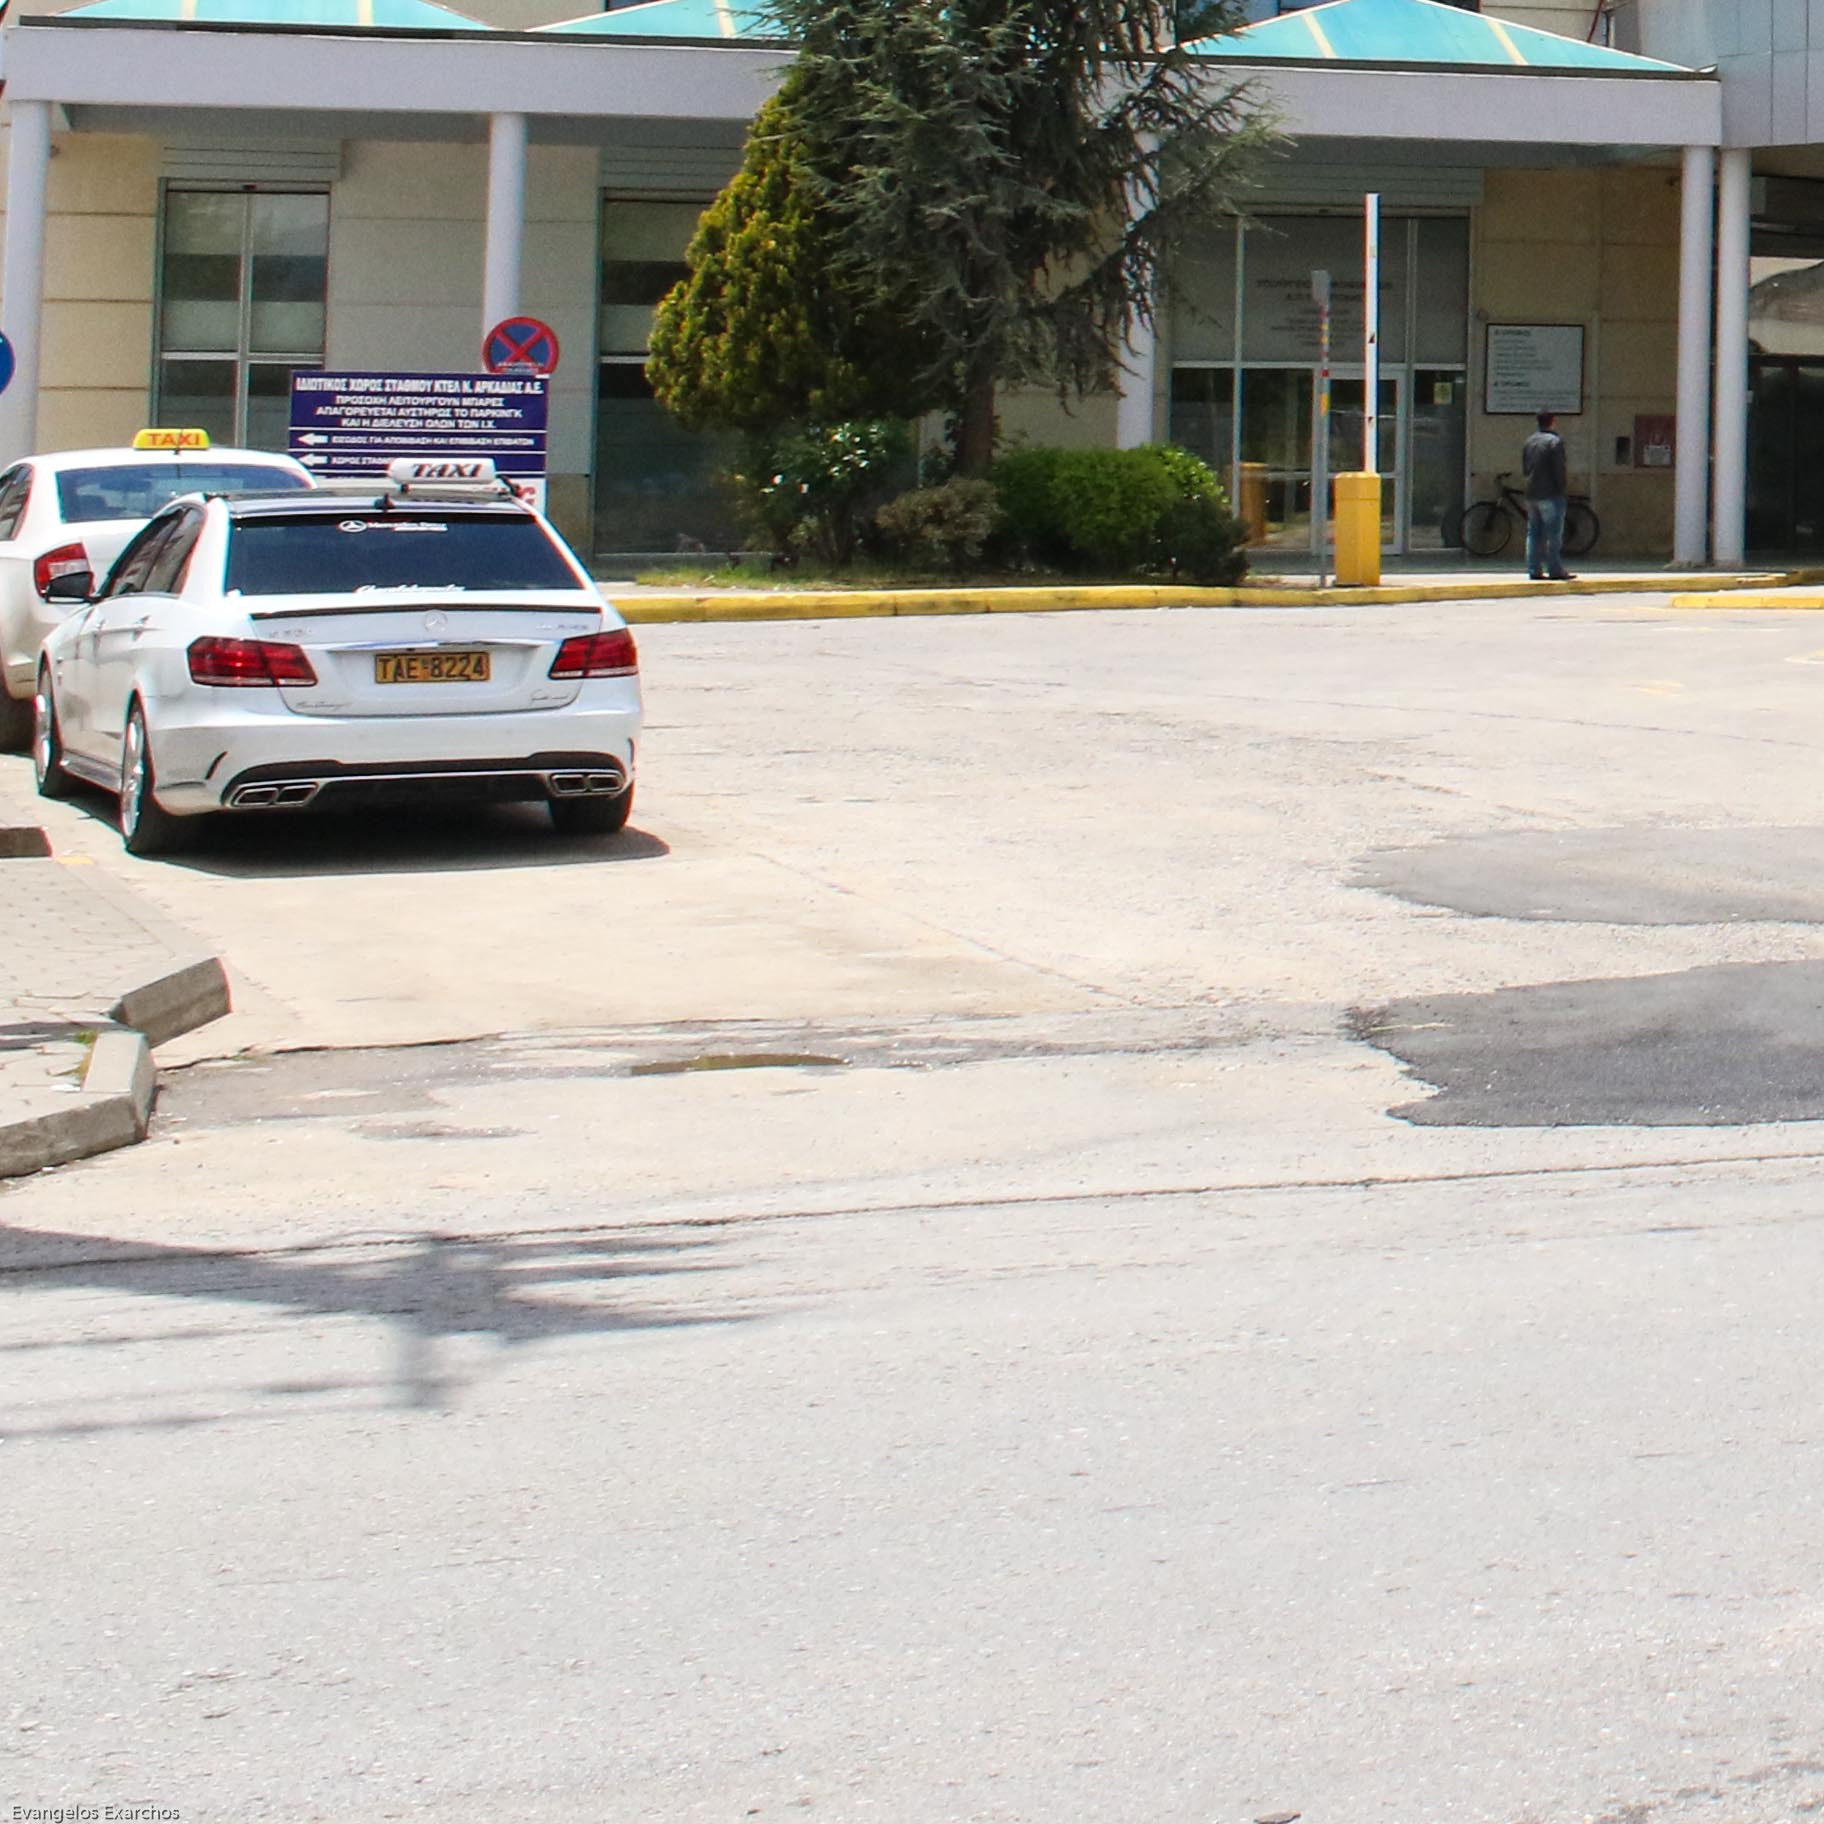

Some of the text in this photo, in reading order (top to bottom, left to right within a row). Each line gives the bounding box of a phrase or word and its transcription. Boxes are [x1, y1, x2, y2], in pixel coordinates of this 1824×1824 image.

[434, 380, 460, 394] ΚΤΕΛ
[474, 381, 524, 394] ΑΡΚΑΔΙΑΣ
[336, 395, 505, 407] ΠΡΟΣΟΧΗ ΛΕΙΤΟΥΡΓΟΥΝ ΜΠΑΡΕΣ
[316, 406, 397, 416] ΑΠΑΓΟΡΕΥΕΤΑΙ
[398, 407, 452, 417] ΑΥΣΤΗΡΩΣ
[454, 408, 469, 417] ΤΟ
[342, 418, 360, 427] ΚΑΙ
[362, 419, 370, 427] Η
[371, 418, 423, 428] ΔΙΕΛΕΥΣΗ
[458, 419, 480, 428] ΤΩΝ
[147, 433, 200, 446] TAXI
[412, 463, 483, 477] TAXI
